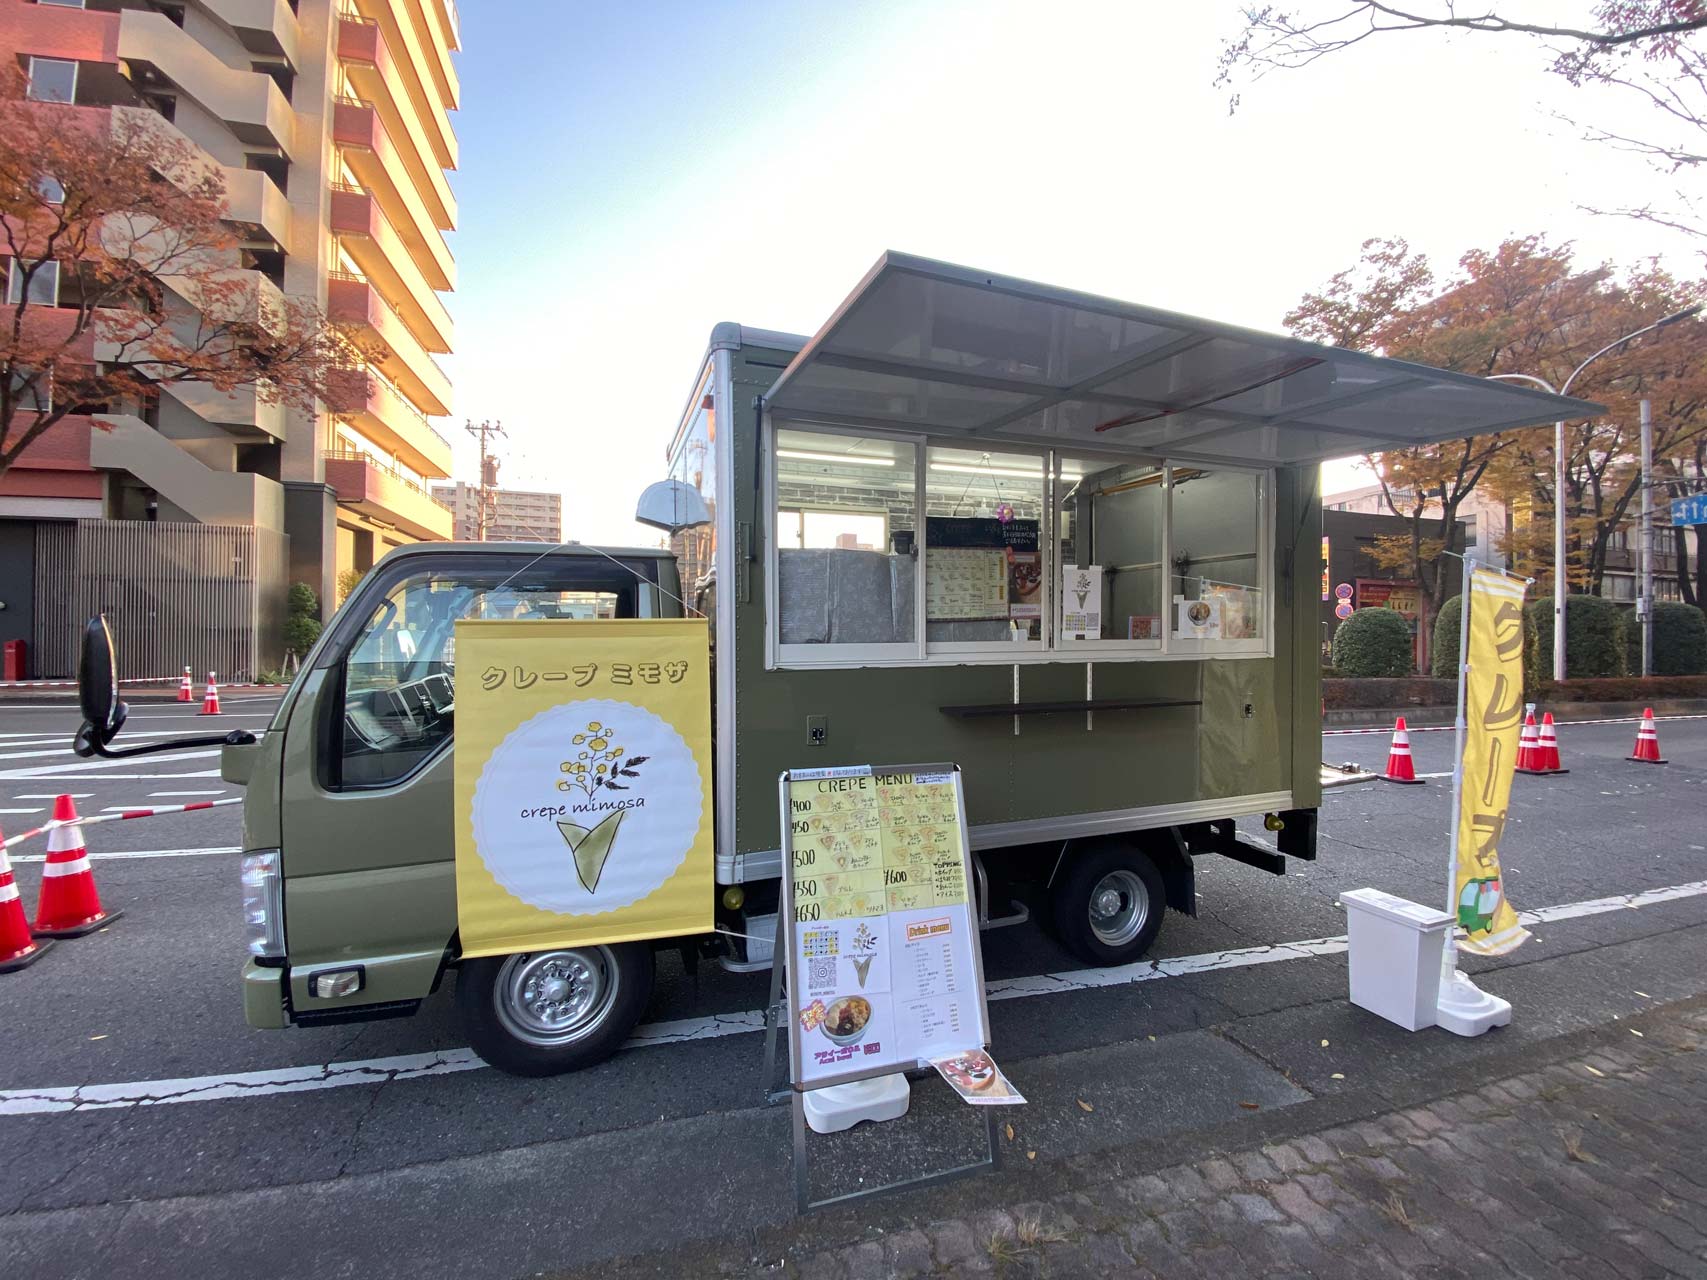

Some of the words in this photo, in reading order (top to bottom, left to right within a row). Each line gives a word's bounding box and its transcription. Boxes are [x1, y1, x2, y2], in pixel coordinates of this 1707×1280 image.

[481, 663, 598, 691] クレープ
[610, 660, 689, 686] ミモザ
[1472, 601, 1523, 868] クレープ
[818, 777, 867, 793] CREPE
[875, 774, 913, 786] MENU
[520, 803, 566, 821] crepe
[572, 797, 645, 814] mimosa
